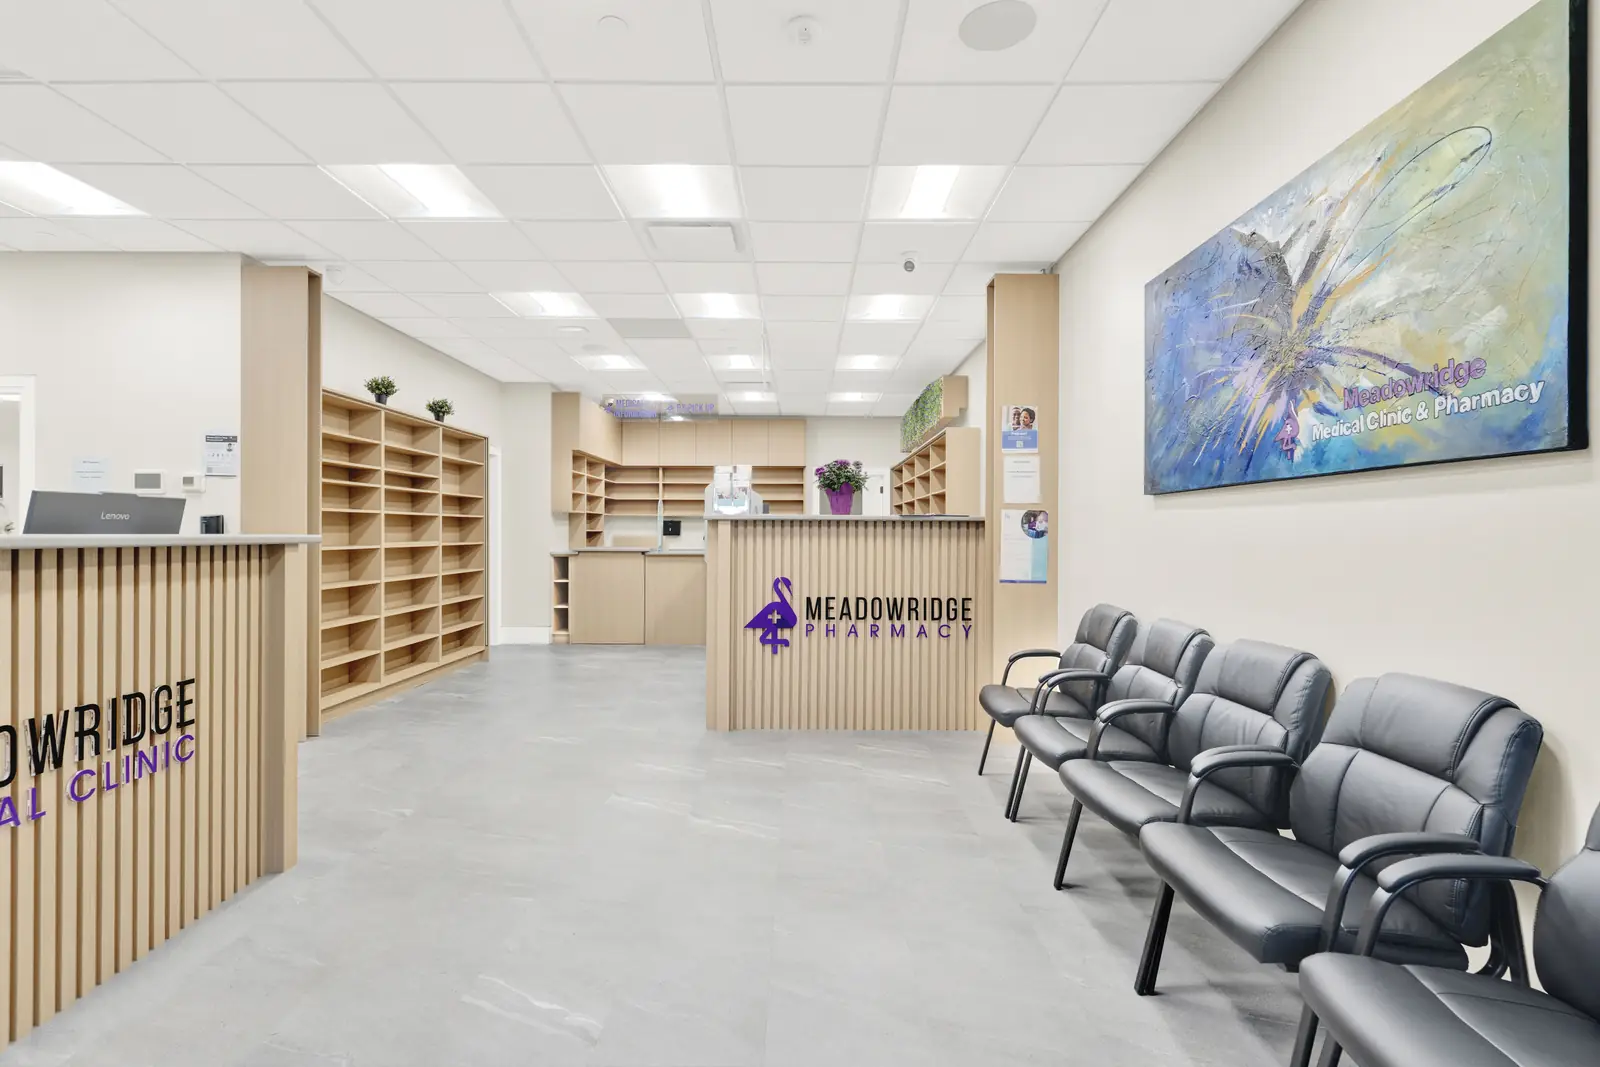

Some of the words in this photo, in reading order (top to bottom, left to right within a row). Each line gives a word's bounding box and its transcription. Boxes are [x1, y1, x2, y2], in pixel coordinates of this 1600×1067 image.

[1343, 356, 1488, 411] Meadowridge
[1311, 413, 1364, 441] Medical
[1366, 404, 1412, 431] Clinic
[1415, 401, 1429, 421] &
[1433, 380, 1546, 419] Pharmacy
[101, 511, 130, 520] Lenovo
[805, 596, 973, 622] MEADOWRIDGE
[805, 623, 973, 640] PHARMACY
[68, 734, 195, 803] CLINIC
